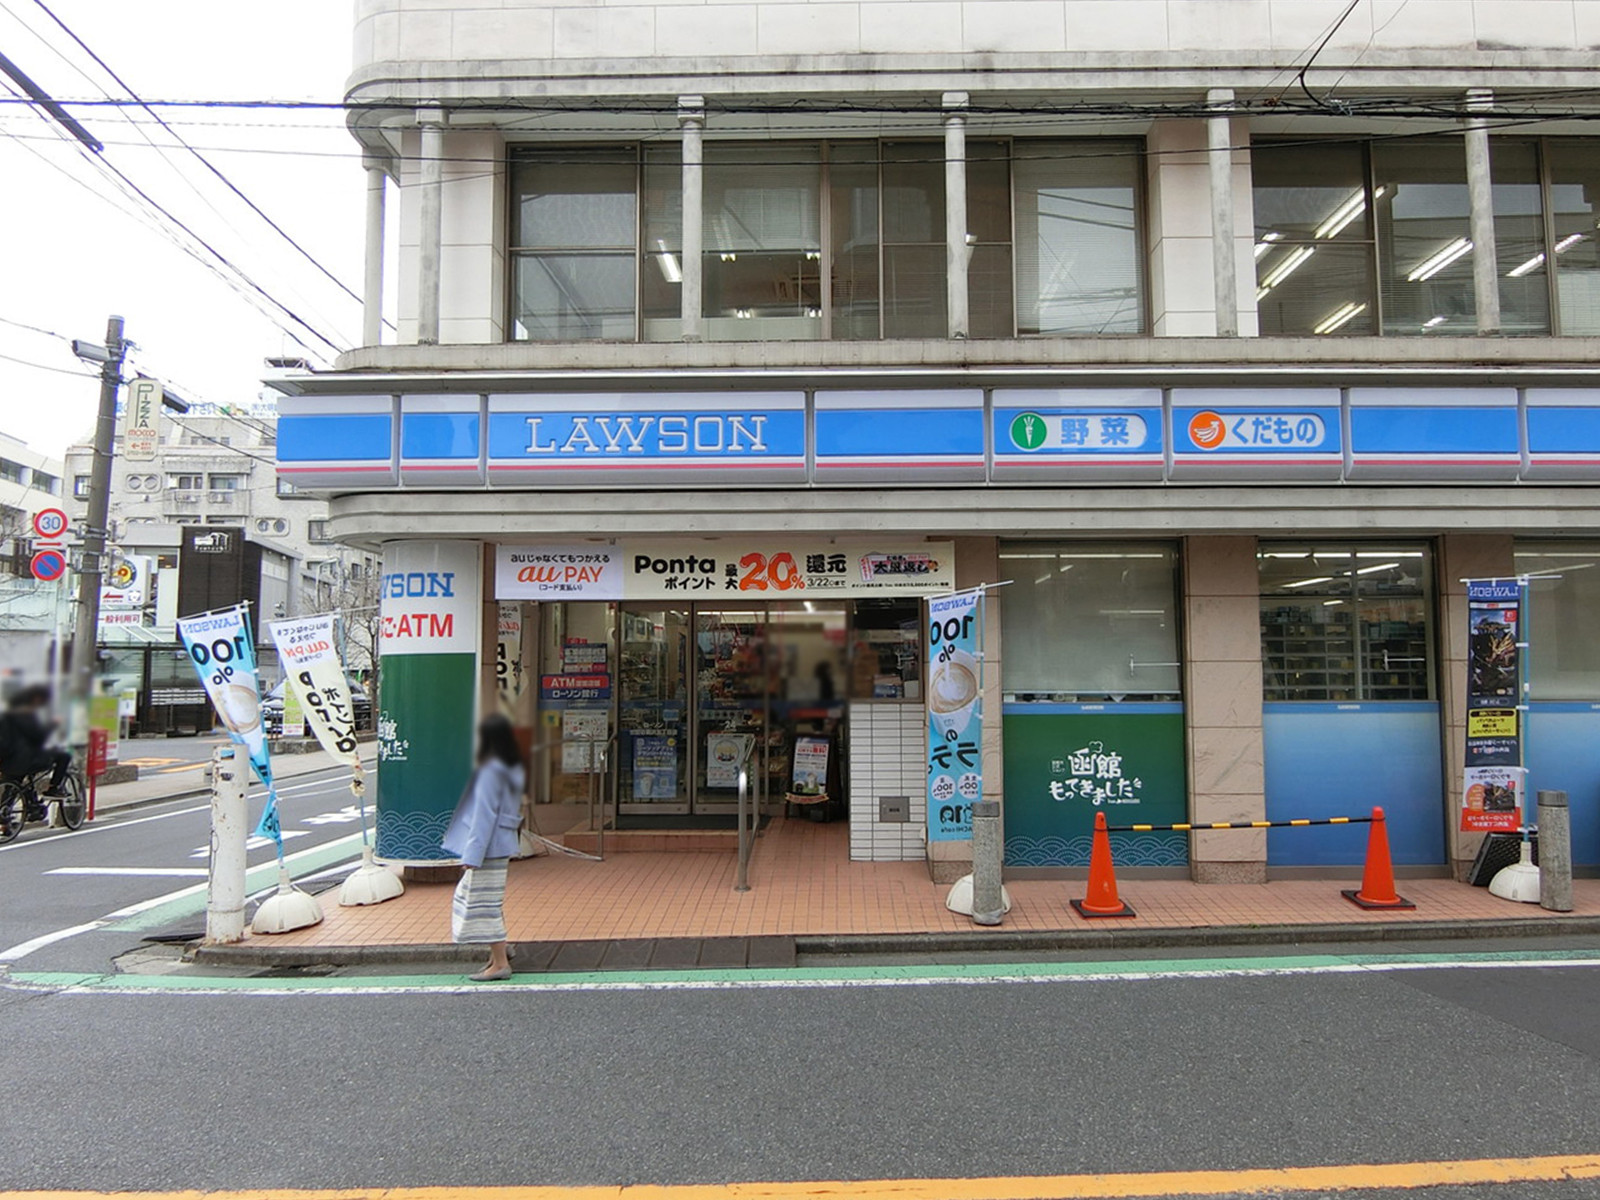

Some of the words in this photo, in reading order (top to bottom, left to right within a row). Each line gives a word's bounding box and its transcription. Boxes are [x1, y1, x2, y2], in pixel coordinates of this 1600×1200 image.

[135, 384, 154, 428] PIZZA
[525, 415, 768, 454] LAWSON
[1061, 417, 1130, 446] 野菜
[1230, 417, 1317, 445] くだもの
[41, 516, 61, 531] 30
[517, 565, 562, 583] au
[565, 566, 604, 583] PAY
[634, 555, 716, 575] Ponta
[806, 554, 847, 574] 還元
[665, 577, 716, 590] ポイント
[551, 678, 575, 687] ATM
[1067, 747, 1123, 779] 函館
[1048, 777, 1134, 806] もってきました
